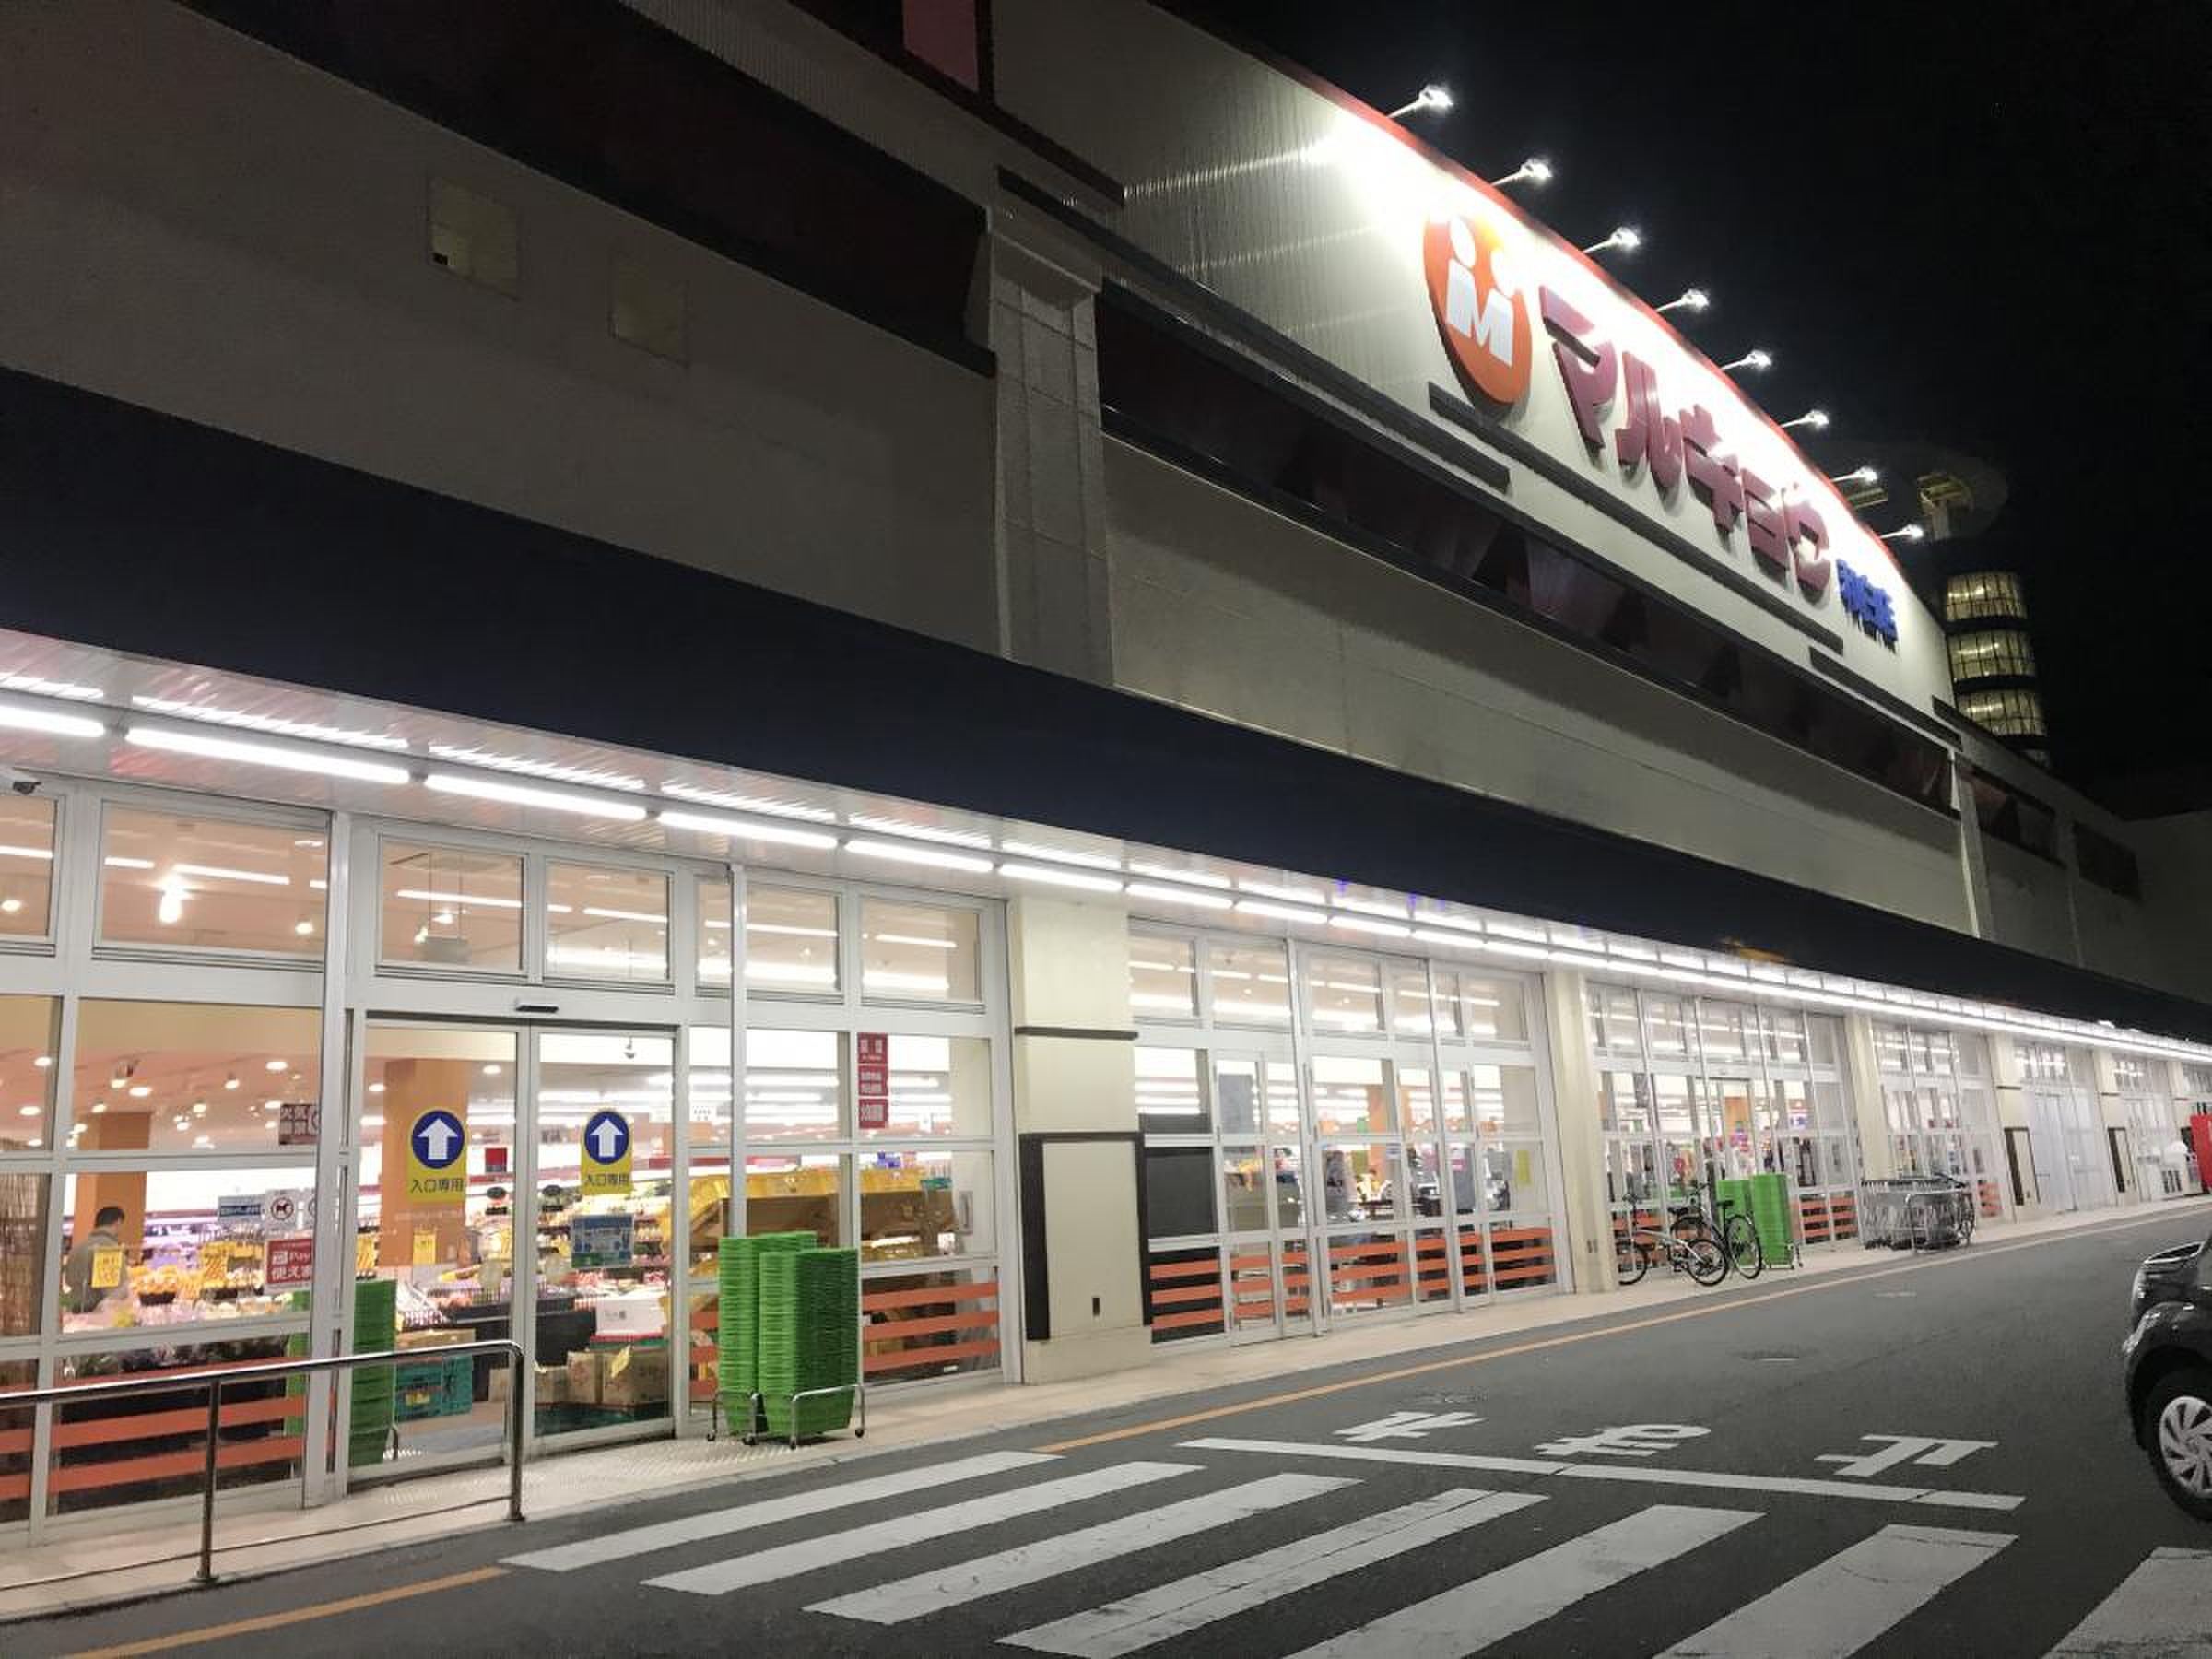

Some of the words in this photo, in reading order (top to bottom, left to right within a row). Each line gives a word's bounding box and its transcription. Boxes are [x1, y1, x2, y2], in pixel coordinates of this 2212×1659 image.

[1539, 284, 1830, 593] マルキョウ
[410, 1178, 465, 1194] 入口専用
[584, 1173, 630, 1187] 入口専用
